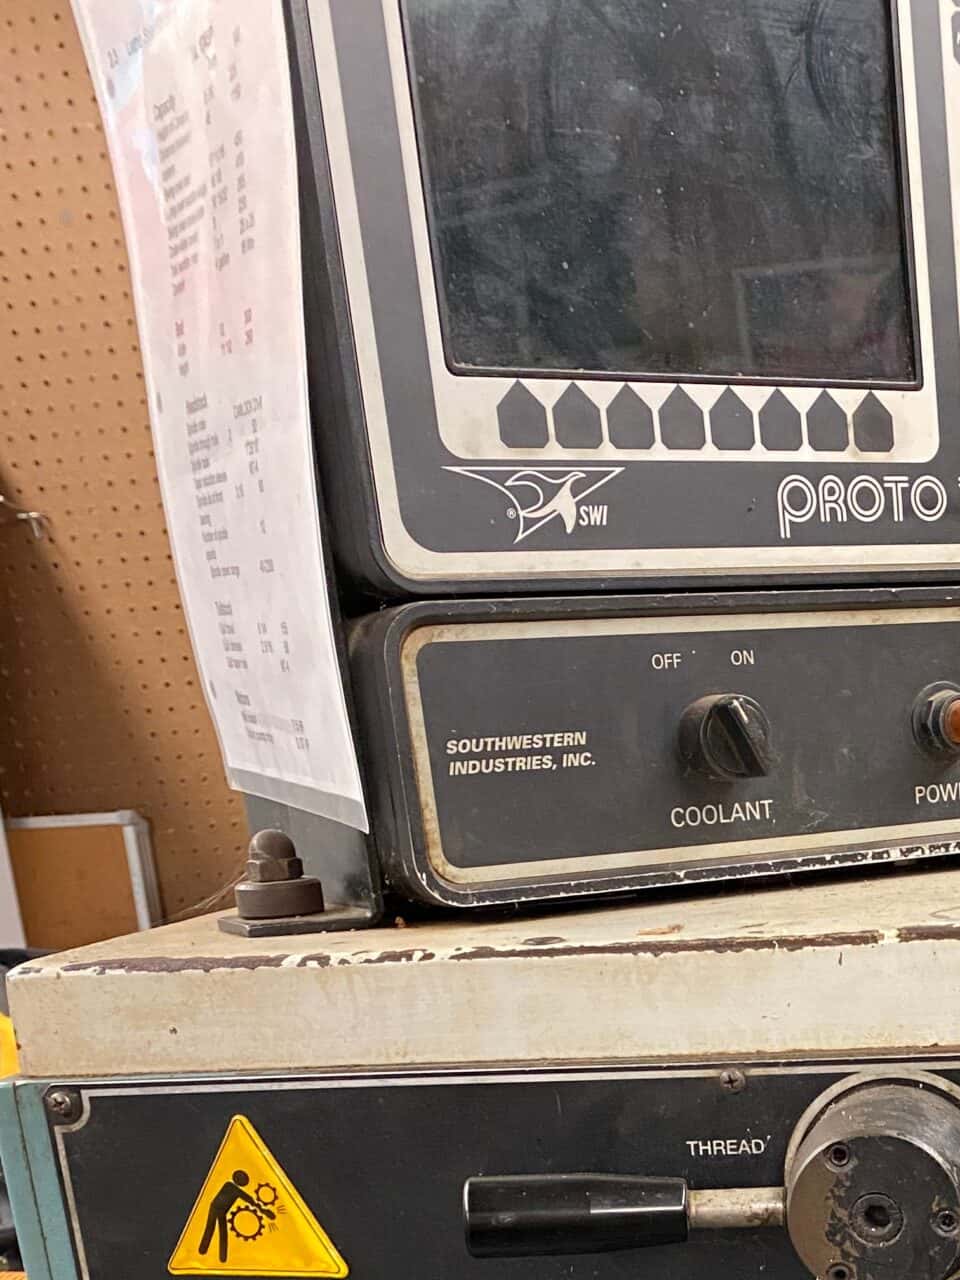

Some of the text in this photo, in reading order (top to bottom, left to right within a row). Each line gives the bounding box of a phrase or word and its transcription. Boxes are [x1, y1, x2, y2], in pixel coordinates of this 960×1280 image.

[578, 505, 609, 527] SWI
[776, 473, 948, 540] PROTO
[651, 652, 682, 671] OFF
[730, 648, 756, 667] ON
[445, 730, 588, 755] SOUTHWESTERN
[447, 751, 597, 777] INDUSTRIES, INC.
[670, 799, 774, 829] COOLANT
[686, 1138, 766, 1157] THREAD
